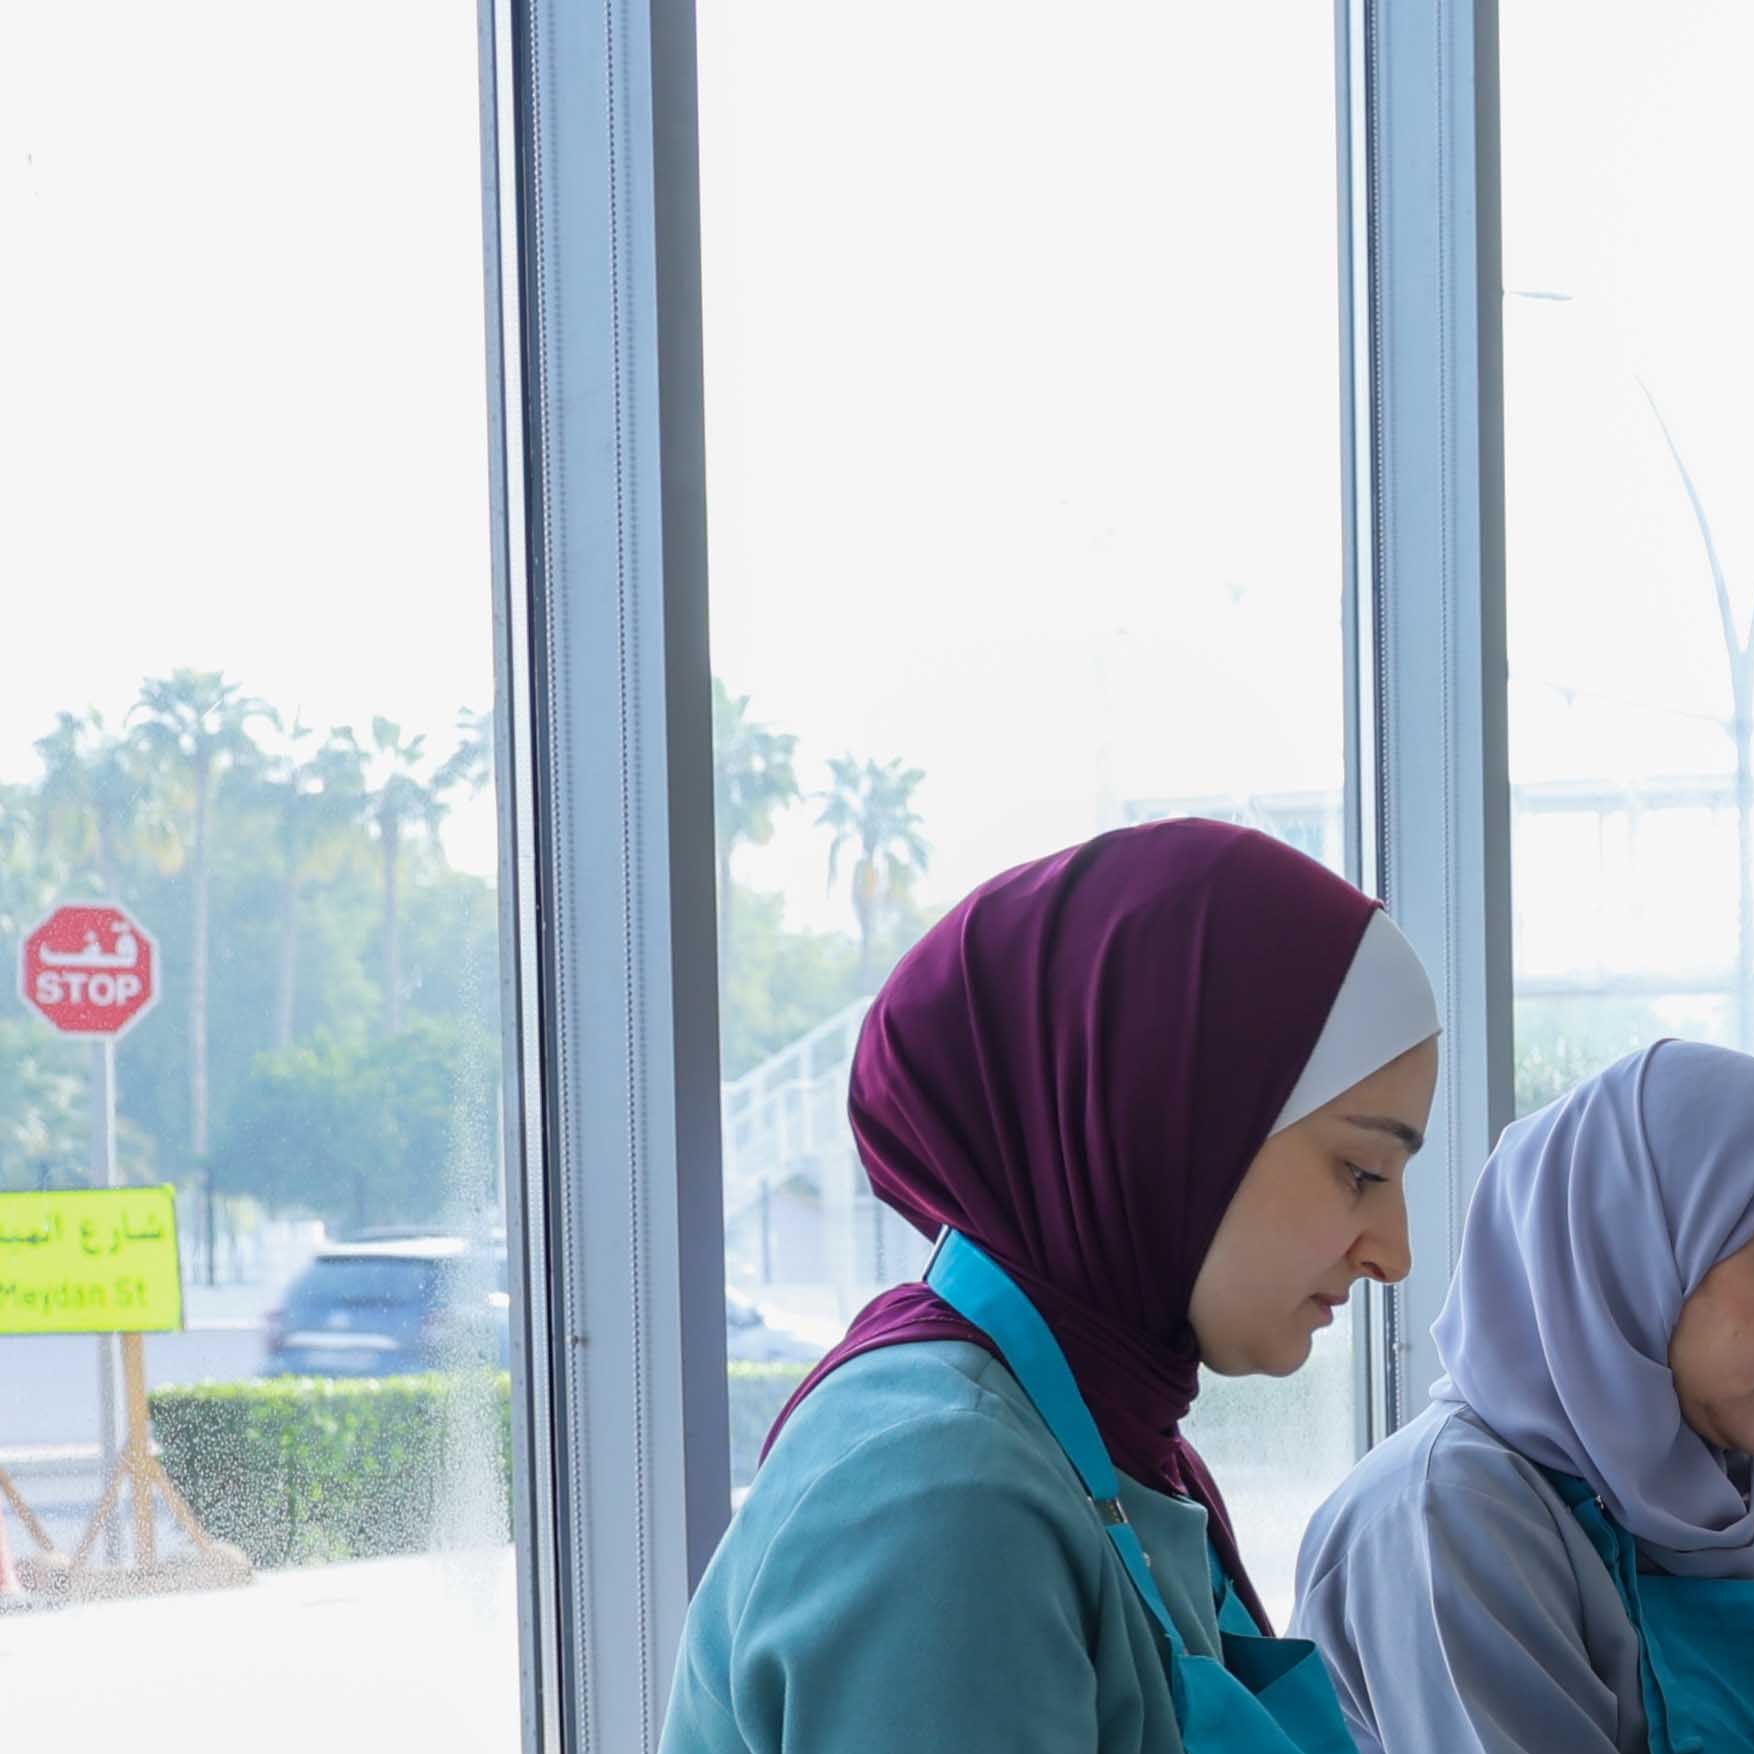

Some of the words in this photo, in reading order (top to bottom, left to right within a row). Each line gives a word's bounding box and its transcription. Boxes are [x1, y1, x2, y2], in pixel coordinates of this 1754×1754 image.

[40, 920, 138, 967] قف
[35, 971, 142, 1008] STOP
[114, 1276, 149, 1309] St
